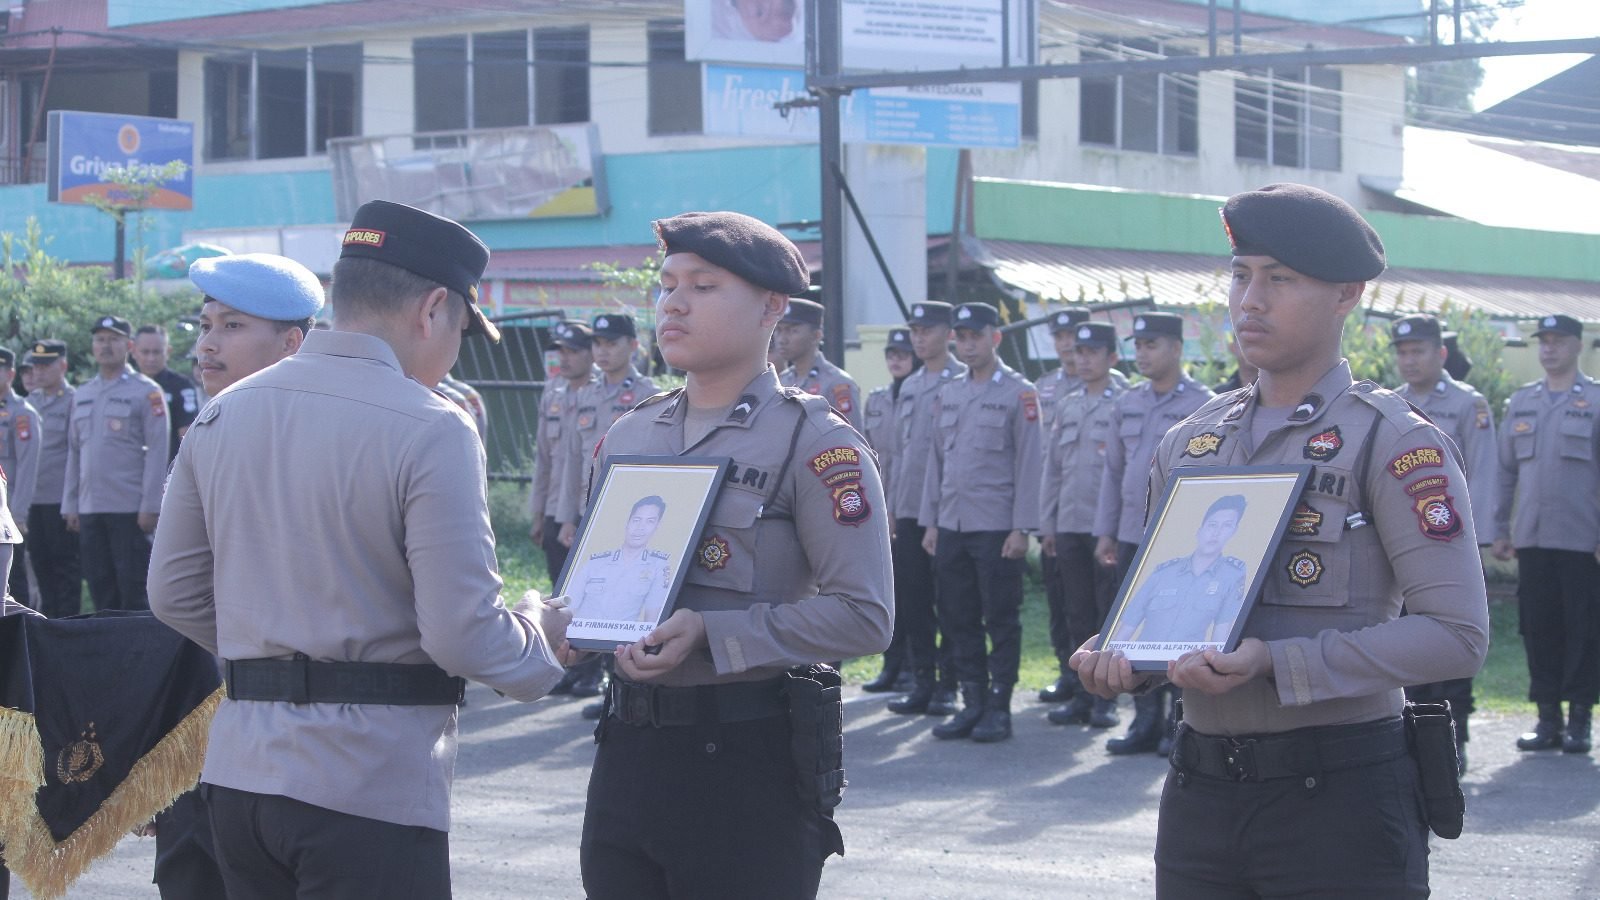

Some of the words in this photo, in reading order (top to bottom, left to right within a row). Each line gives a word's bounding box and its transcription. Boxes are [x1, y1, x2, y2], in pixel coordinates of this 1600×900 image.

[814, 448, 855, 467] POLRES
[814, 454, 858, 472] KETAPANG
[1394, 449, 1437, 468] POLRES
[1395, 455, 1441, 475] KETAPANG
[728, 464, 768, 489] LRI
[1304, 466, 1345, 496] LRI
[584, 621, 636, 631] FIRMANSYAH,
